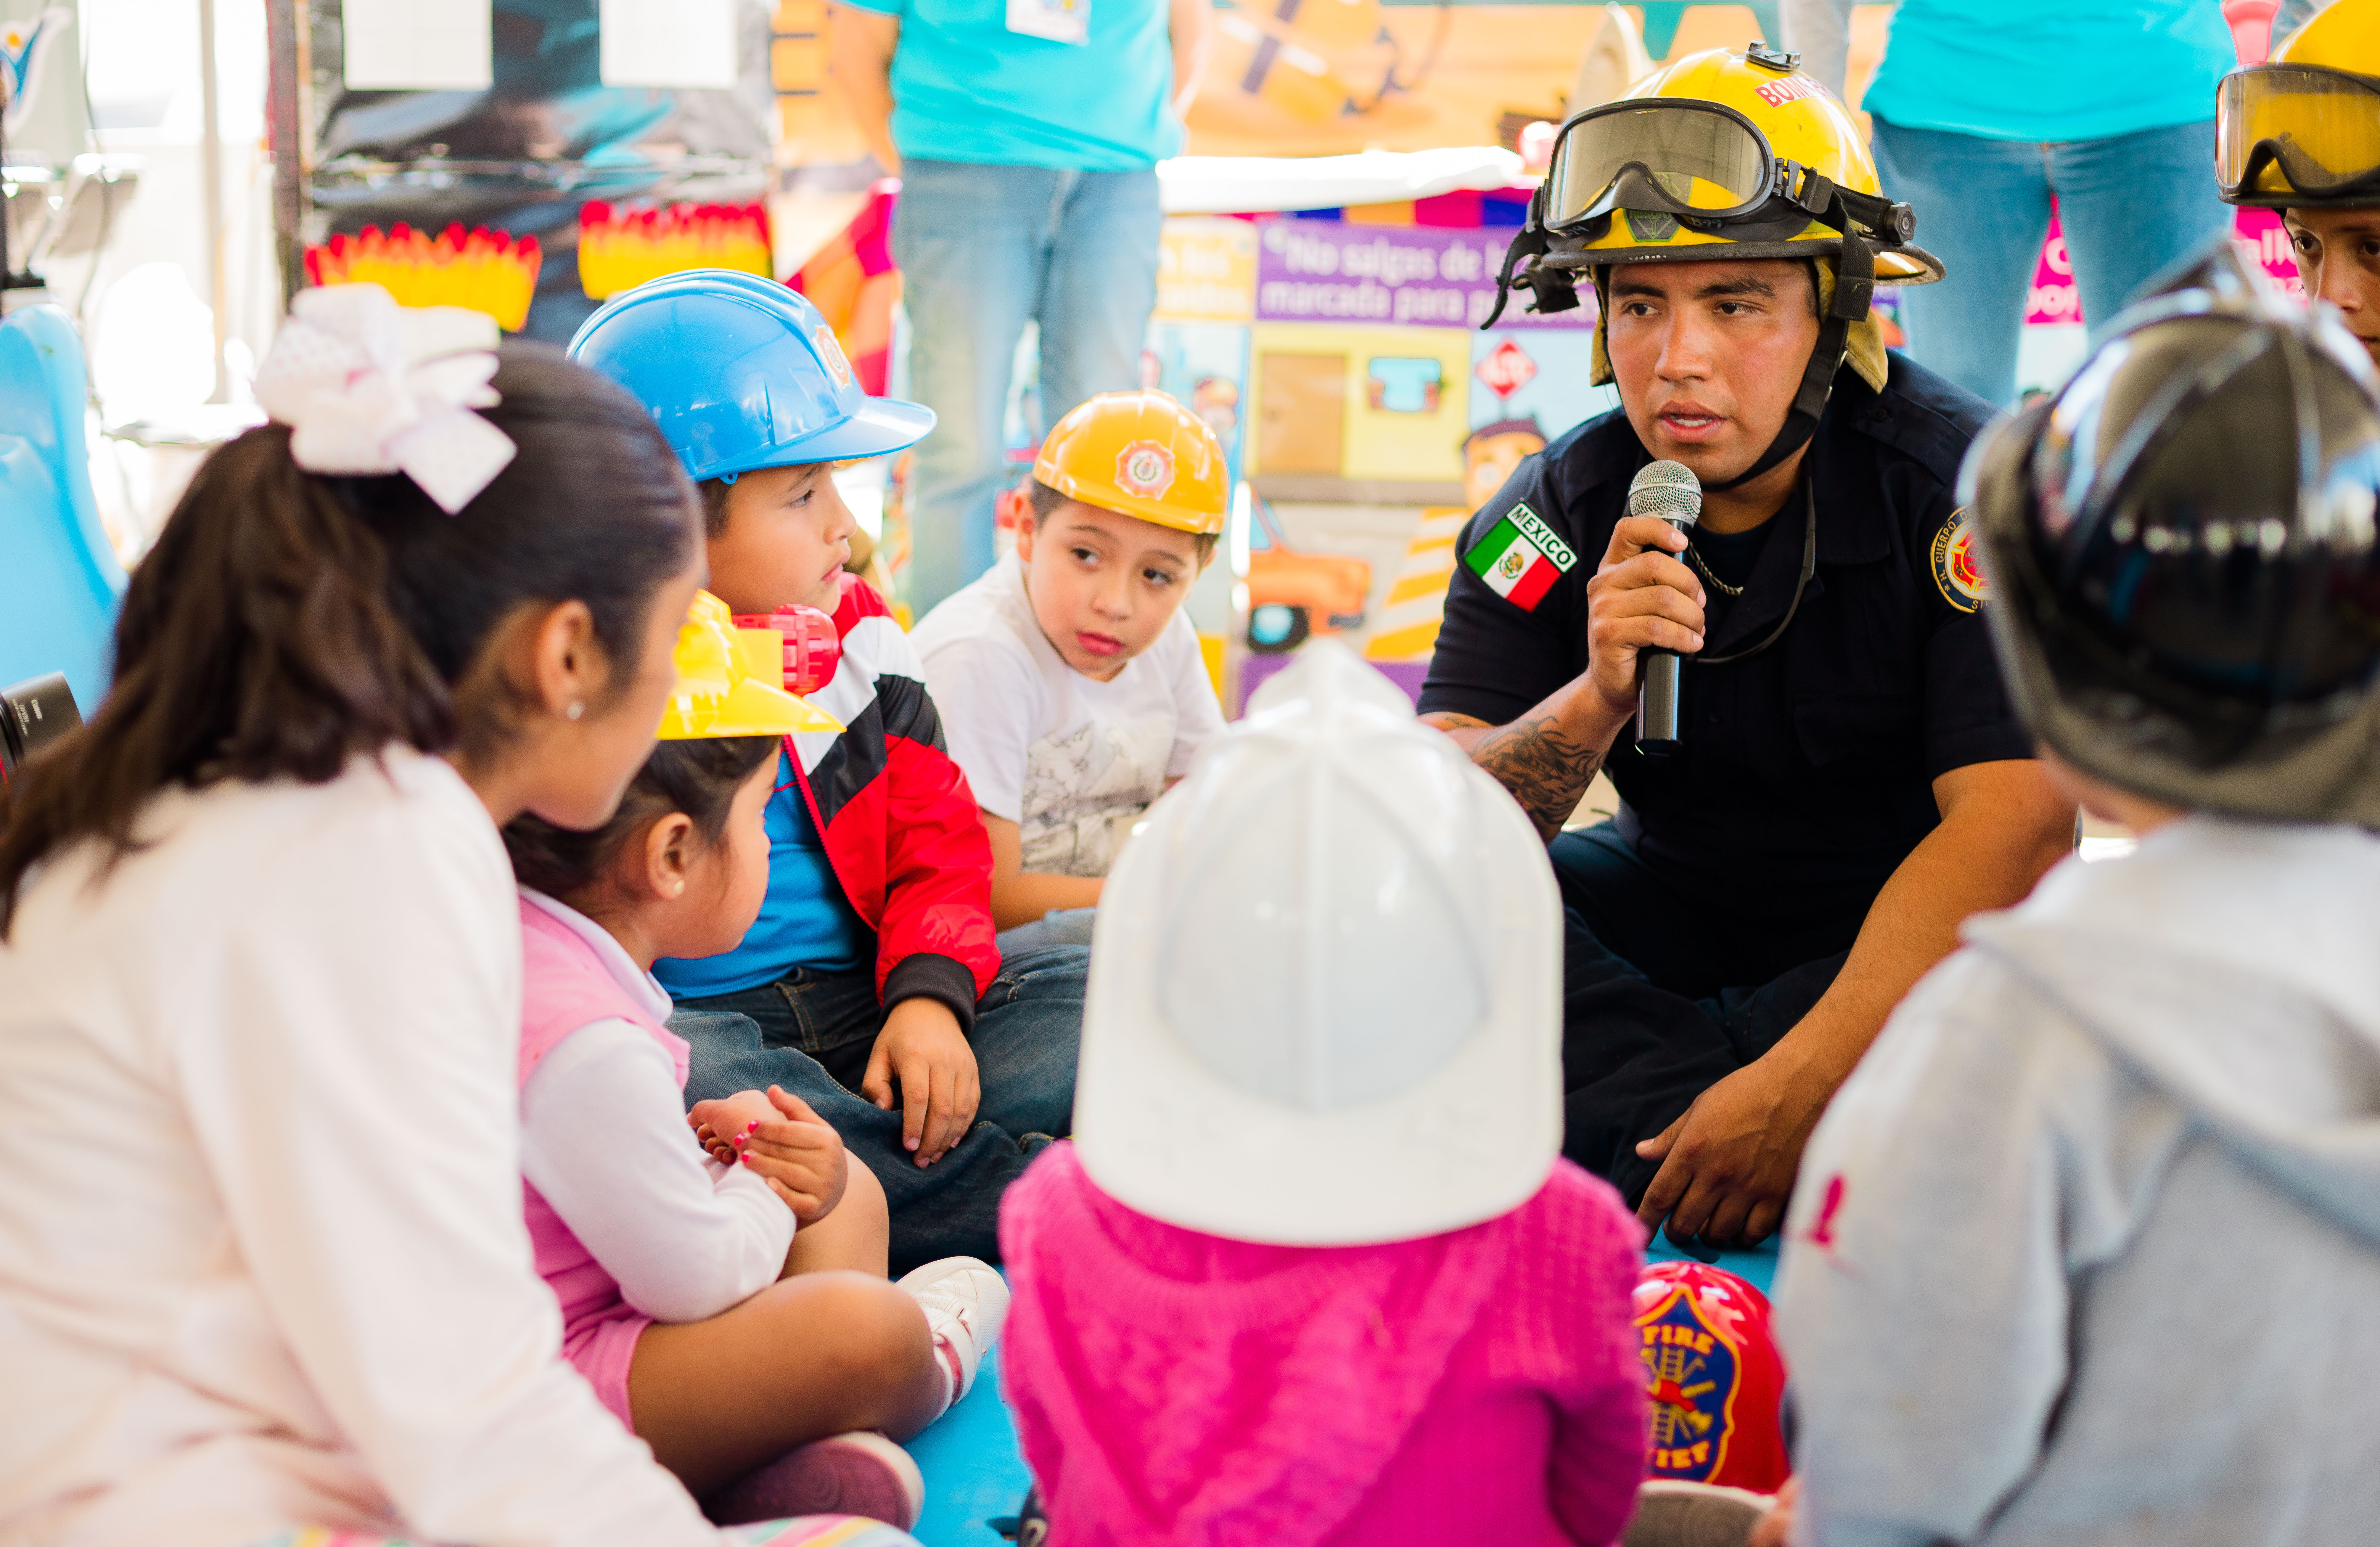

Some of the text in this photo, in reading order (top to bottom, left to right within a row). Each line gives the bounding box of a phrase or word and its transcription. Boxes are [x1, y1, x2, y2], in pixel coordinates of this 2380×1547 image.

[1284, 233, 1339, 275] No
[1341, 234, 1438, 287] salgas
[1439, 239, 1483, 282] de
[1260, 280, 1392, 318] marcada
[1394, 287, 1465, 324] para
[1511, 507, 1571, 565] MEXICO
[1935, 521, 1956, 563] CUERPO
[1642, 1325, 1715, 1355] FIRE
